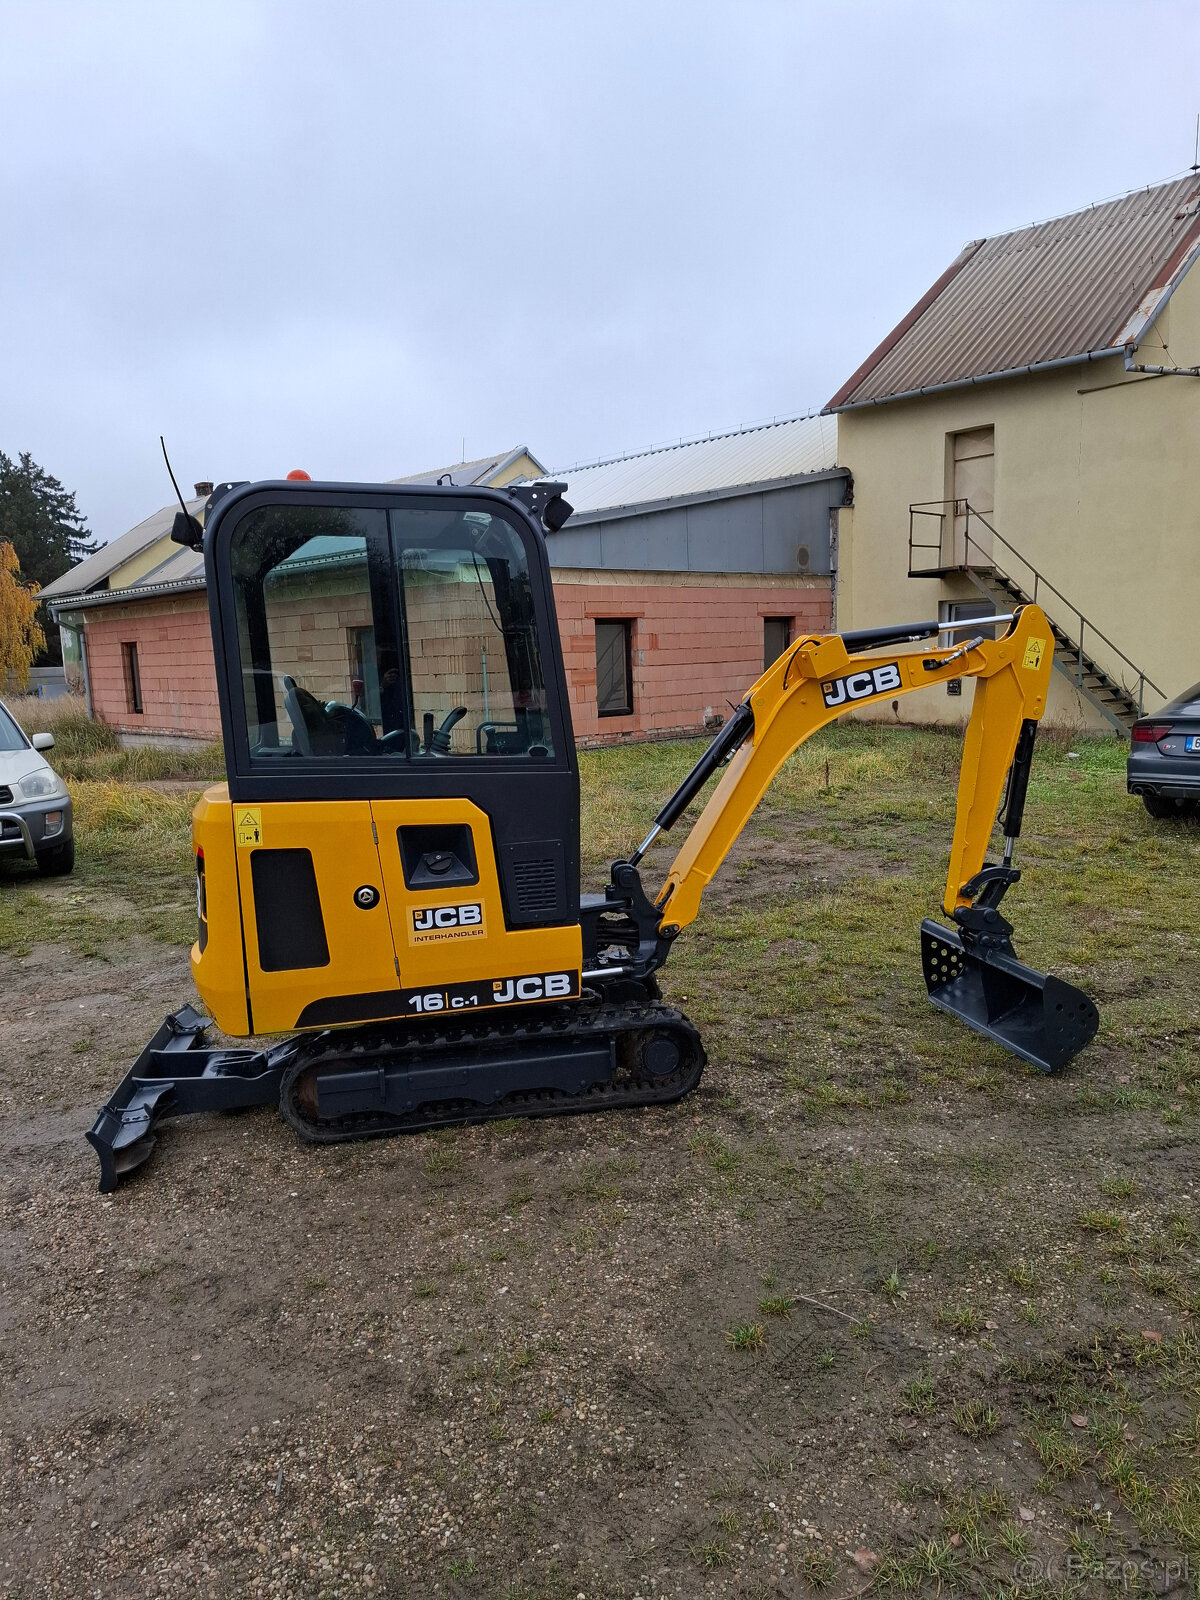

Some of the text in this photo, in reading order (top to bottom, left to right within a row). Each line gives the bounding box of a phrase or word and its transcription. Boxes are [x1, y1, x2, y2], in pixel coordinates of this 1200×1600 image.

[825, 665, 900, 705] JCB
[415, 905, 481, 930] JCB
[414, 929, 484, 942] INTERHANDLER
[493, 974, 571, 1003] JCB
[408, 993, 443, 1012] 16
